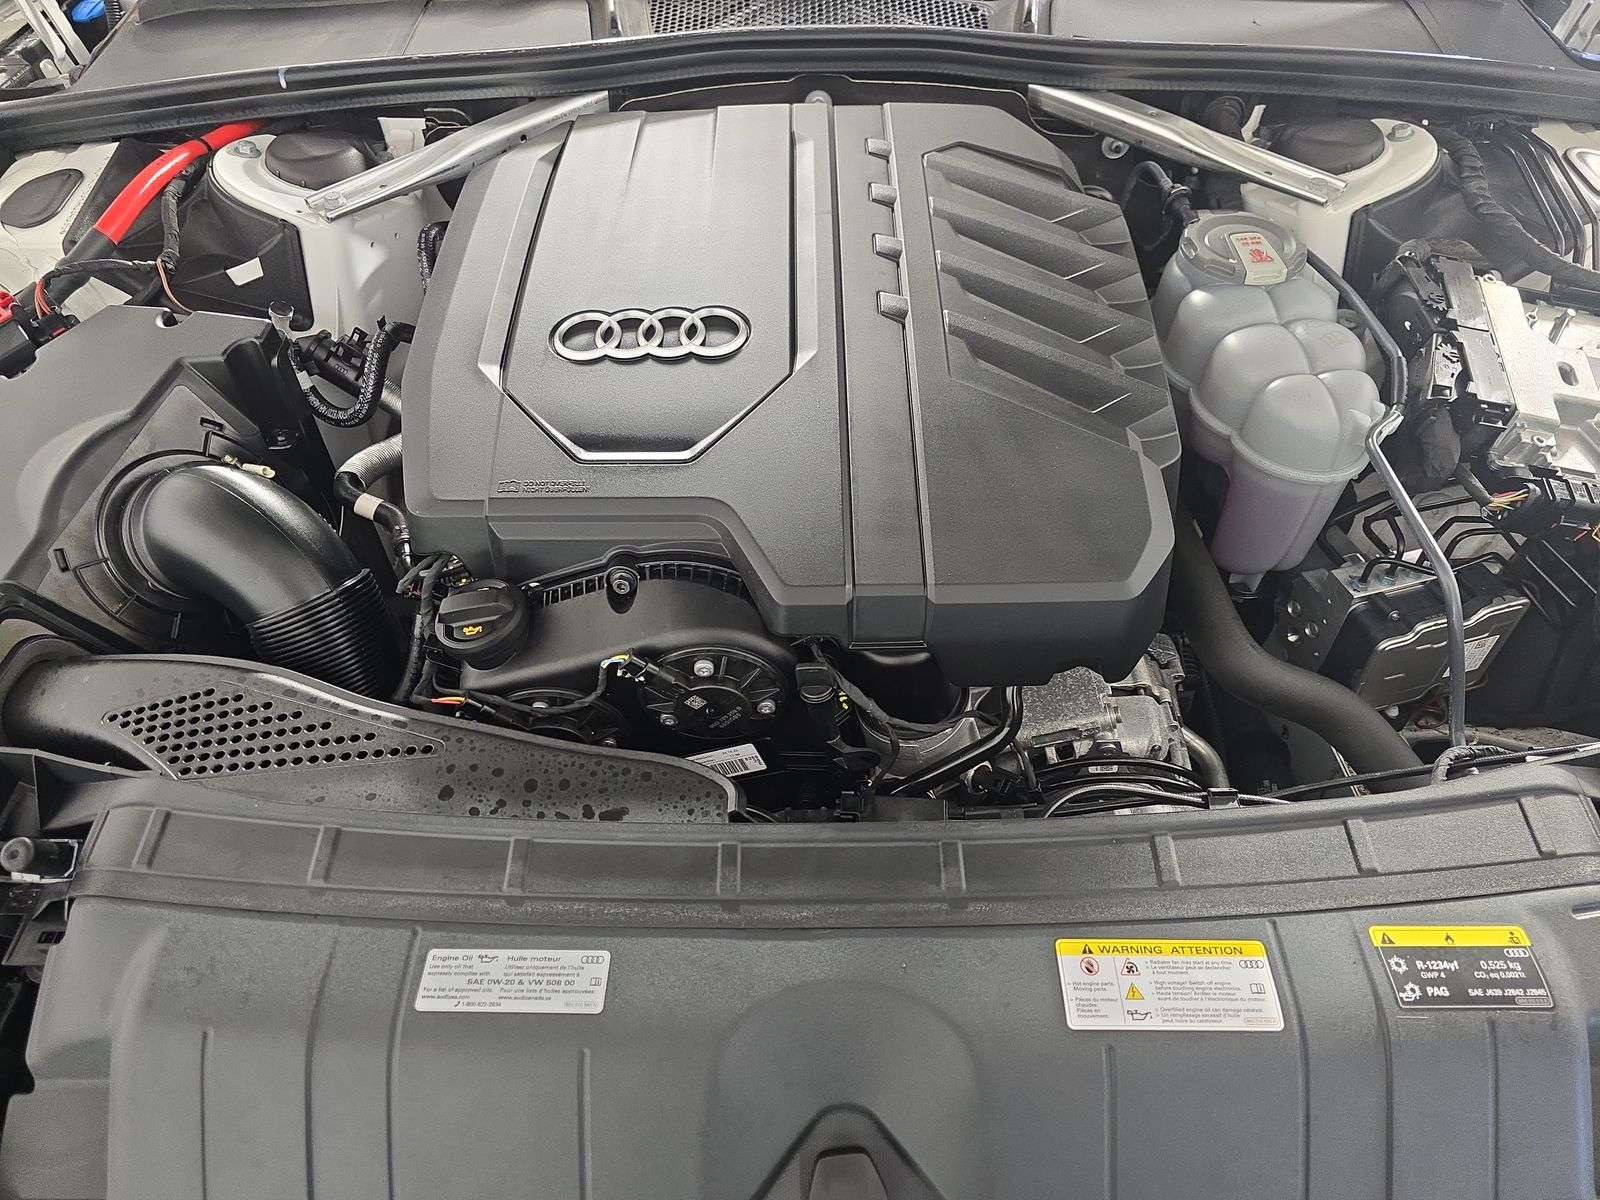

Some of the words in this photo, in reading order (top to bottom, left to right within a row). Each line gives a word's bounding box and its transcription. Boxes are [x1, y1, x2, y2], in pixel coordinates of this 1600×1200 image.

[1097, 945, 1163, 954] WARNING
[1170, 945, 1244, 955] ATTENTION
[432, 954, 460, 962] Engine
[1415, 960, 1460, 971] R-1234yf
[1479, 960, 1507, 970] 0,525
[1508, 960, 1522, 971] kg
[1420, 971, 1440, 979] GWP
[1440, 971, 1446, 979] 4
[487, 978, 515, 986] 0W-20
[1426, 986, 1450, 997] PAG
[1468, 988, 1485, 996] SAE
[1485, 988, 1503, 996] J639
[1503, 988, 1525, 997] J2842
[1525, 988, 1547, 997] J2845
